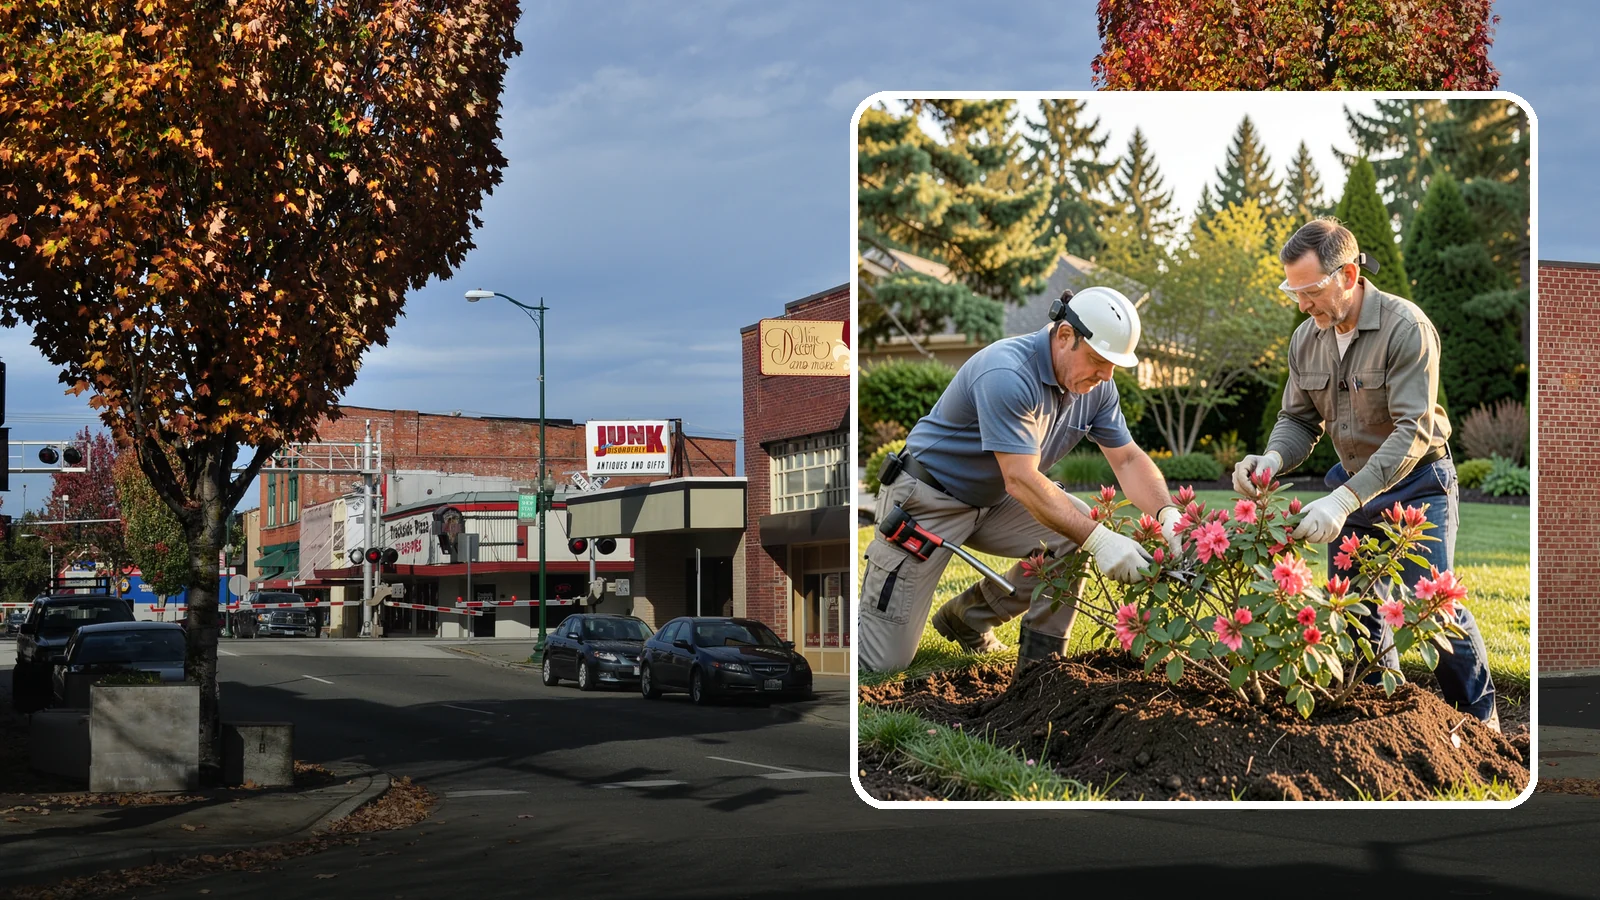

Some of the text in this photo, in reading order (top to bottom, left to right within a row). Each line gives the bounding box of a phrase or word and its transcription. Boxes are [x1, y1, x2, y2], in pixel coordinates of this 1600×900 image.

[595, 425, 665, 457] JUNK
[607, 446, 646, 454] DISORDERLY
[597, 460, 665, 470] ANTIQUES AND GIFTS
[414, 519, 429, 535] Pizza
